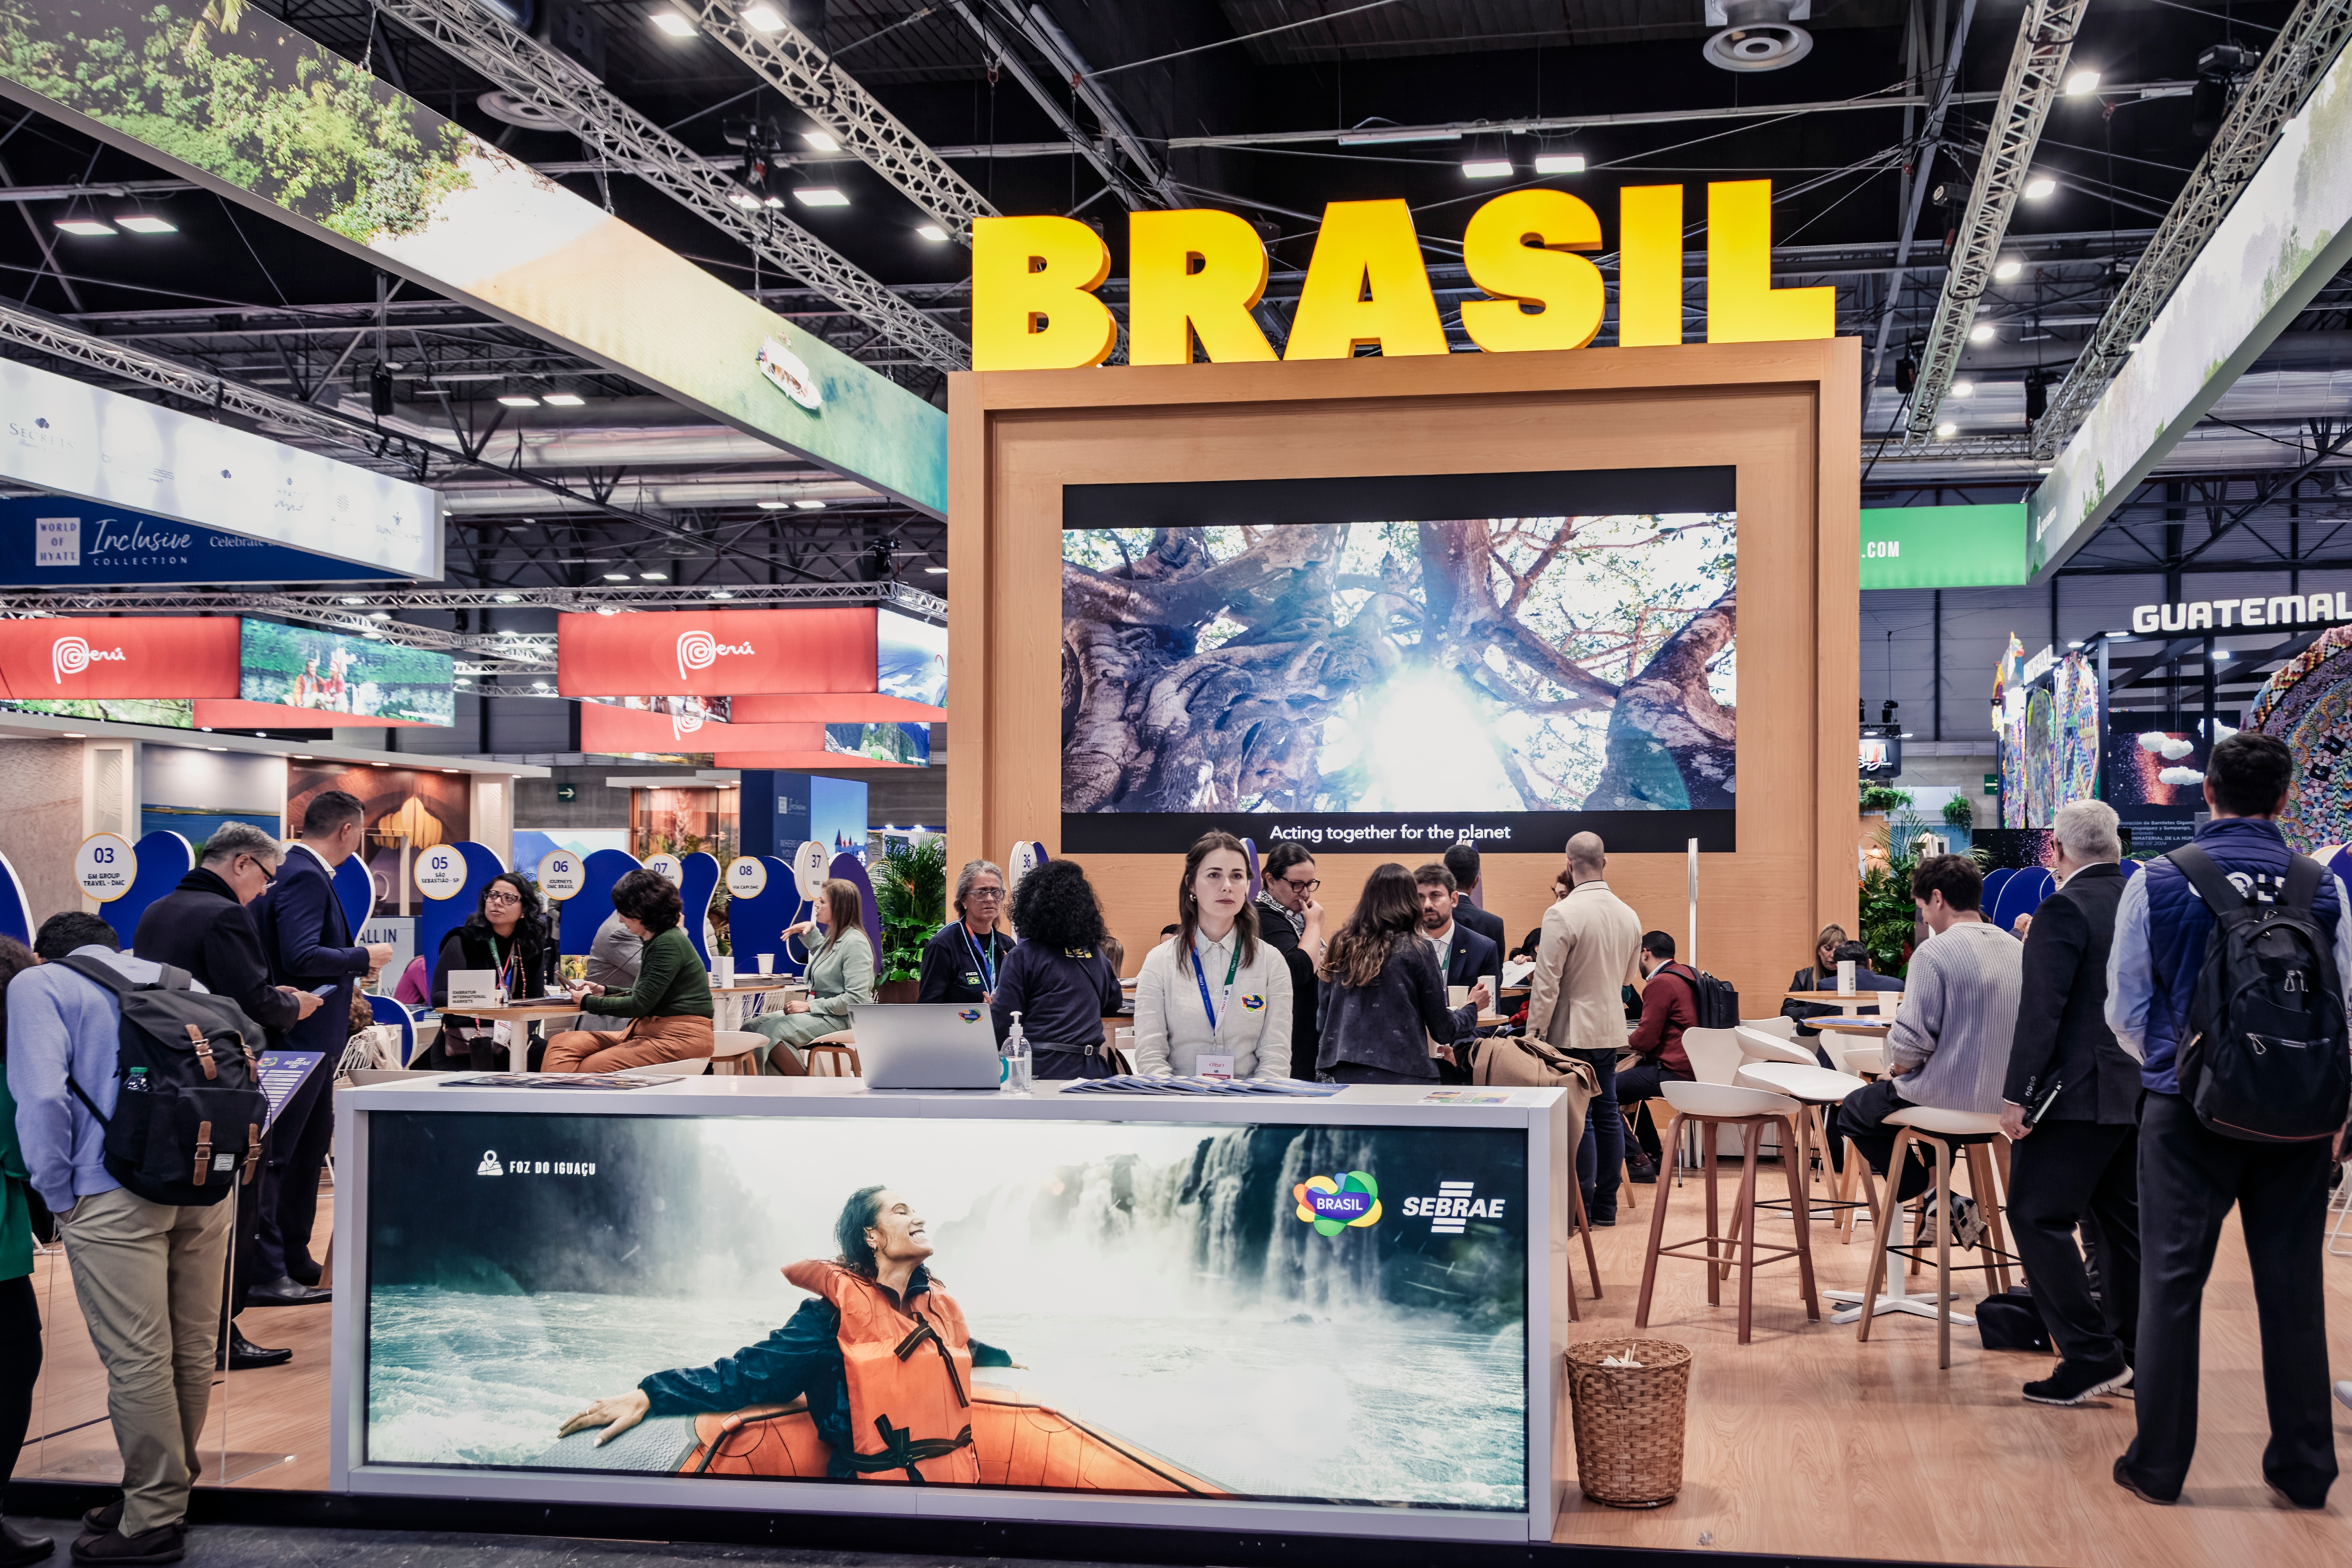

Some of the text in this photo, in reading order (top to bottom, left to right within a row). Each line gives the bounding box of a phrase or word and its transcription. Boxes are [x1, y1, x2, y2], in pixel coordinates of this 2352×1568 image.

[973, 179, 1836, 371] BRASIL
[40, 523, 77, 531] WORLD
[51, 537, 63, 546] OF
[87, 519, 192, 554] Inclusive
[40, 552, 77, 561] HYATT
[93, 556, 188, 566] COLLECTION
[52, 636, 126, 684] Perú
[677, 630, 754, 680] Perú
[1269, 824, 1511, 843] Acting together for the planet
[94, 847, 114, 863] 03
[811, 854, 821, 868] 37
[432, 857, 448, 869] 05
[553, 861, 568, 872] 06
[654, 863, 668, 873] 07
[740, 866, 752, 875] 08
[384, 929, 396, 942] IN
[510, 1161, 596, 1176] FOZ DO IGUAÇU
[1317, 1197, 1364, 1211] BRASIL
[1402, 1196, 1506, 1218] SEBRAE
